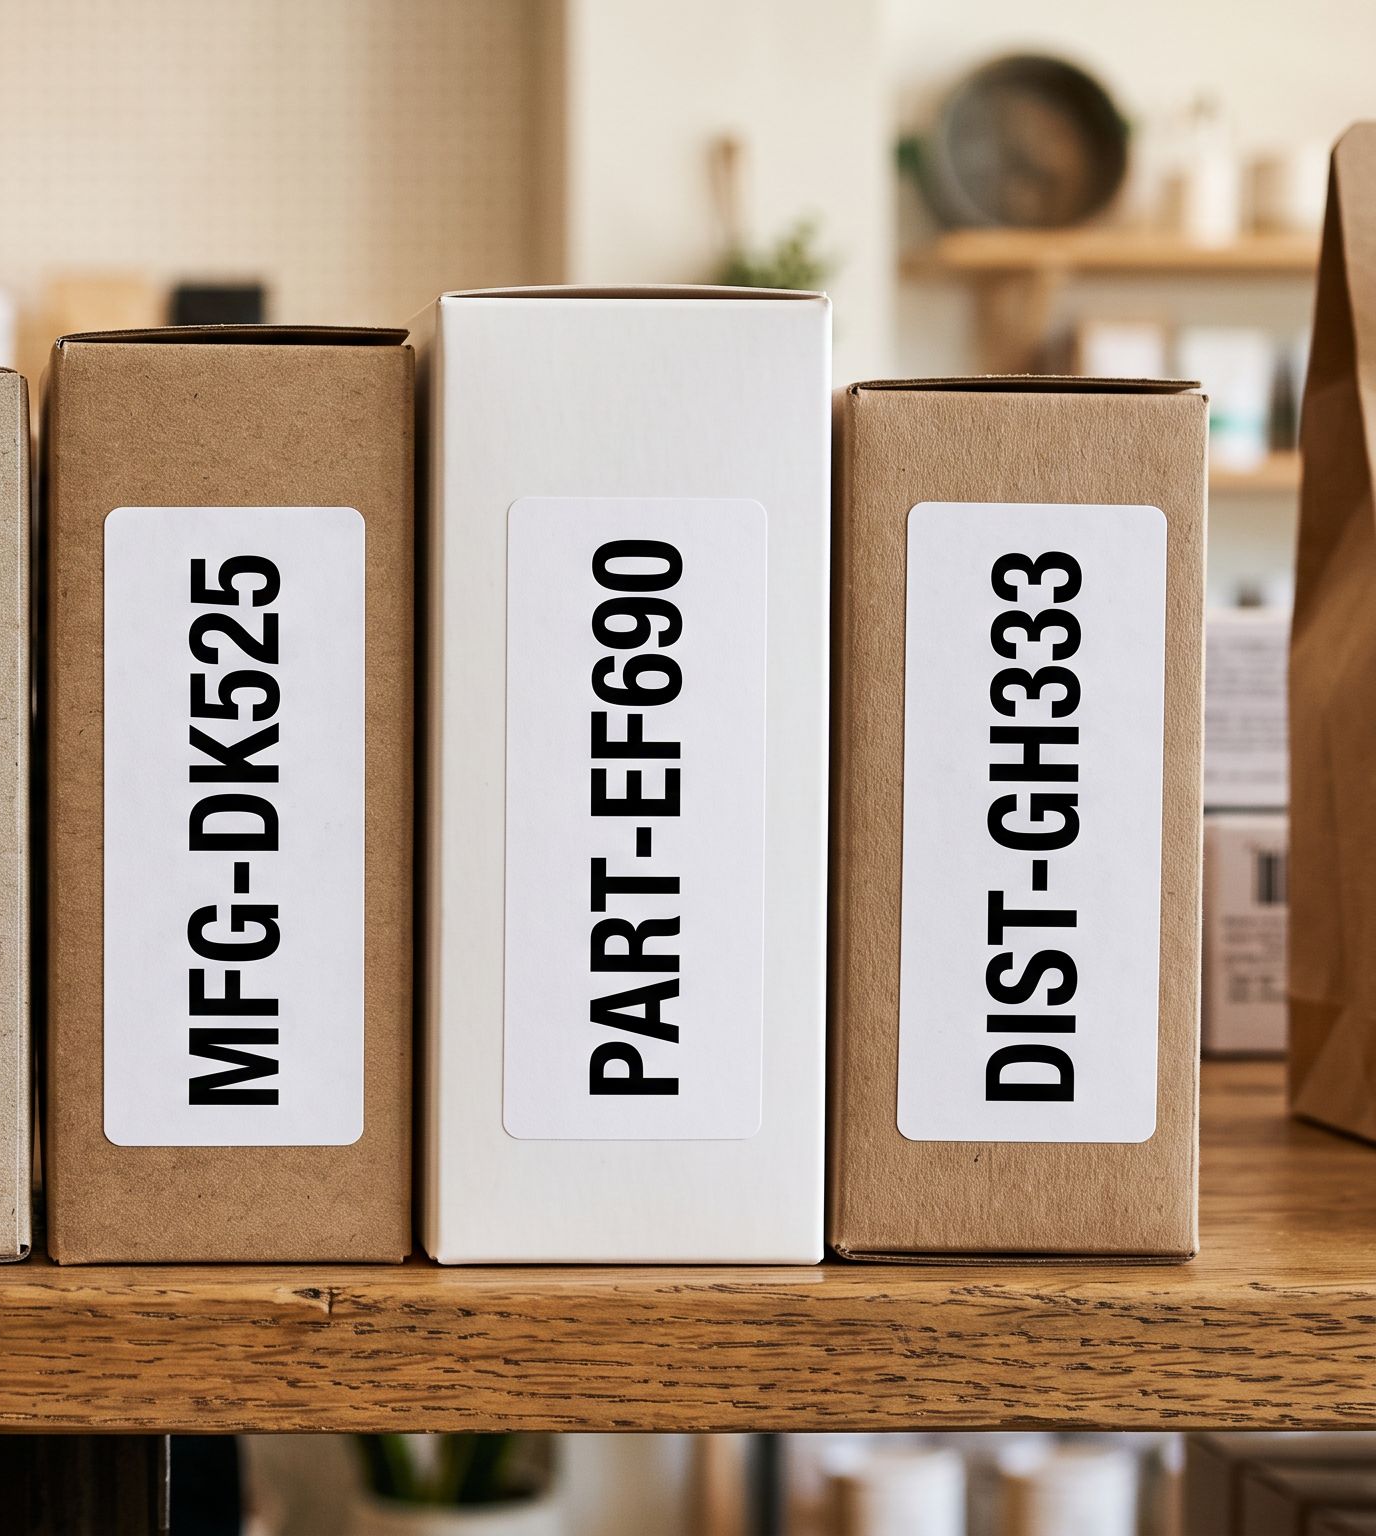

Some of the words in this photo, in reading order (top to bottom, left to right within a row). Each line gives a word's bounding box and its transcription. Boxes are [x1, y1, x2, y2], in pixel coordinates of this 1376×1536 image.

[187, 555, 281, 1106] MFG-DK525
[589, 539, 683, 1096] PART-EF690
[985, 551, 1083, 1102] DIST-GH333
